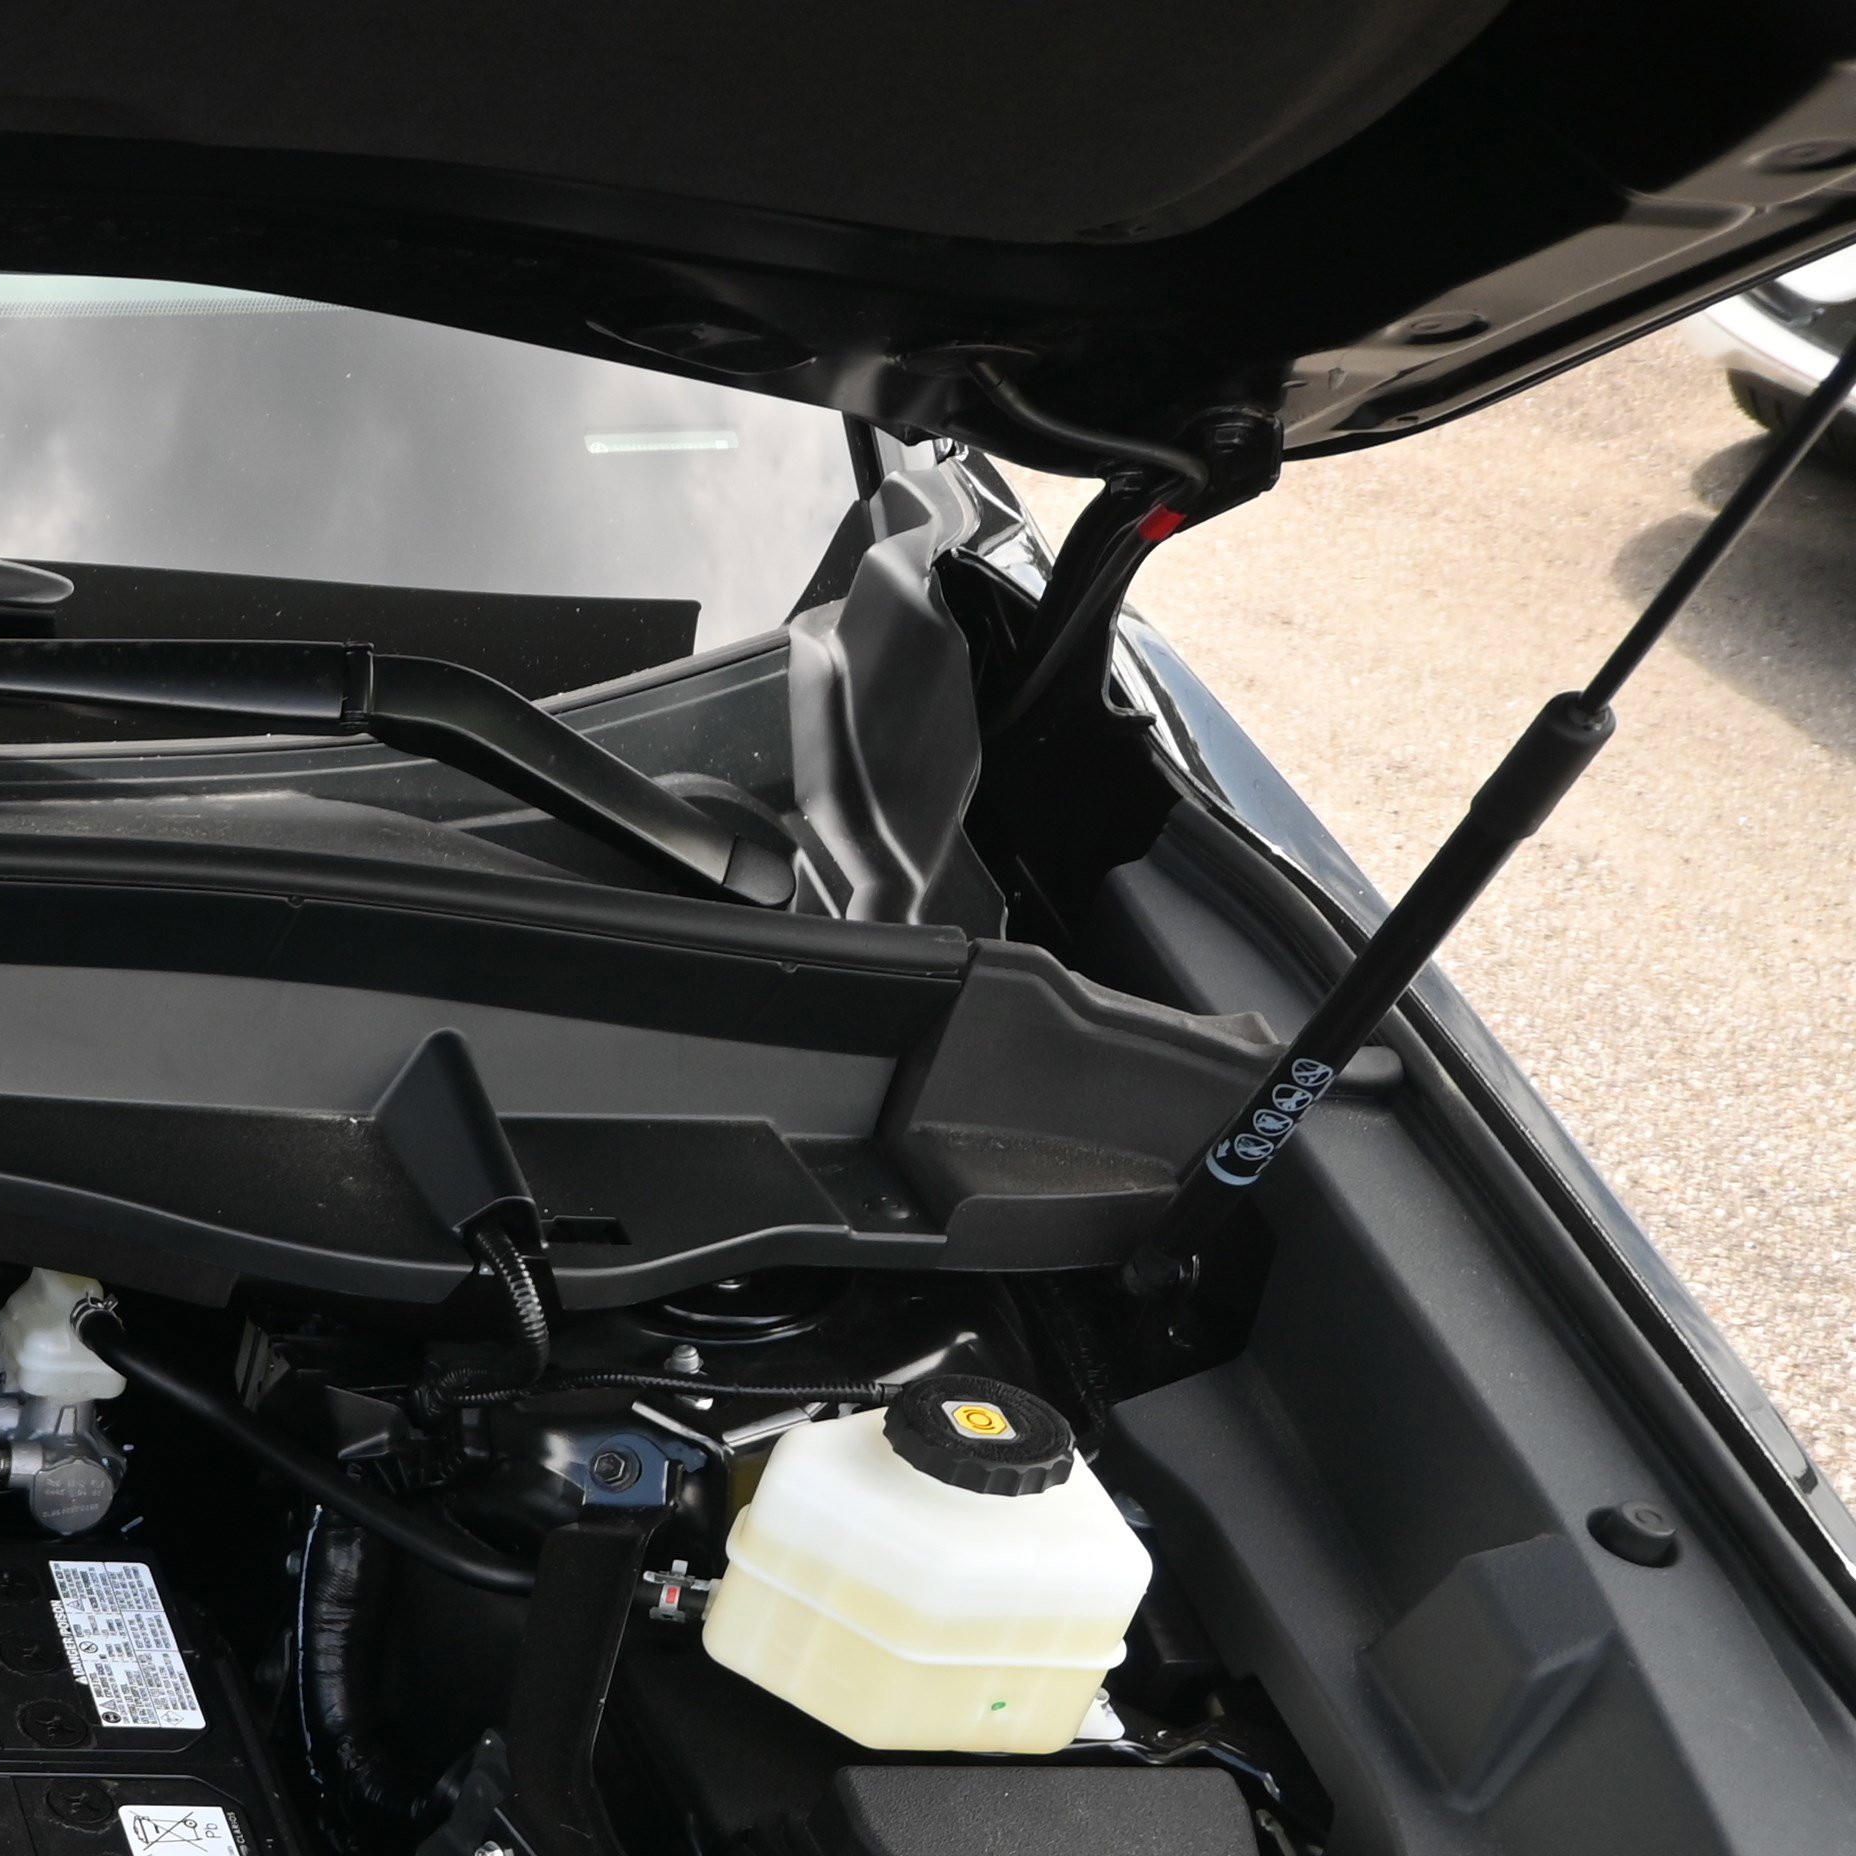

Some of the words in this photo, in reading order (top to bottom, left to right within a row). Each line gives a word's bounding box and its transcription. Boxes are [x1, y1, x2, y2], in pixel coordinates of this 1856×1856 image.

[50, 1600, 84, 1677] DANGER/POISON
[202, 1823, 221, 1838] Pb
[227, 1811, 246, 1843] CLARIOS
